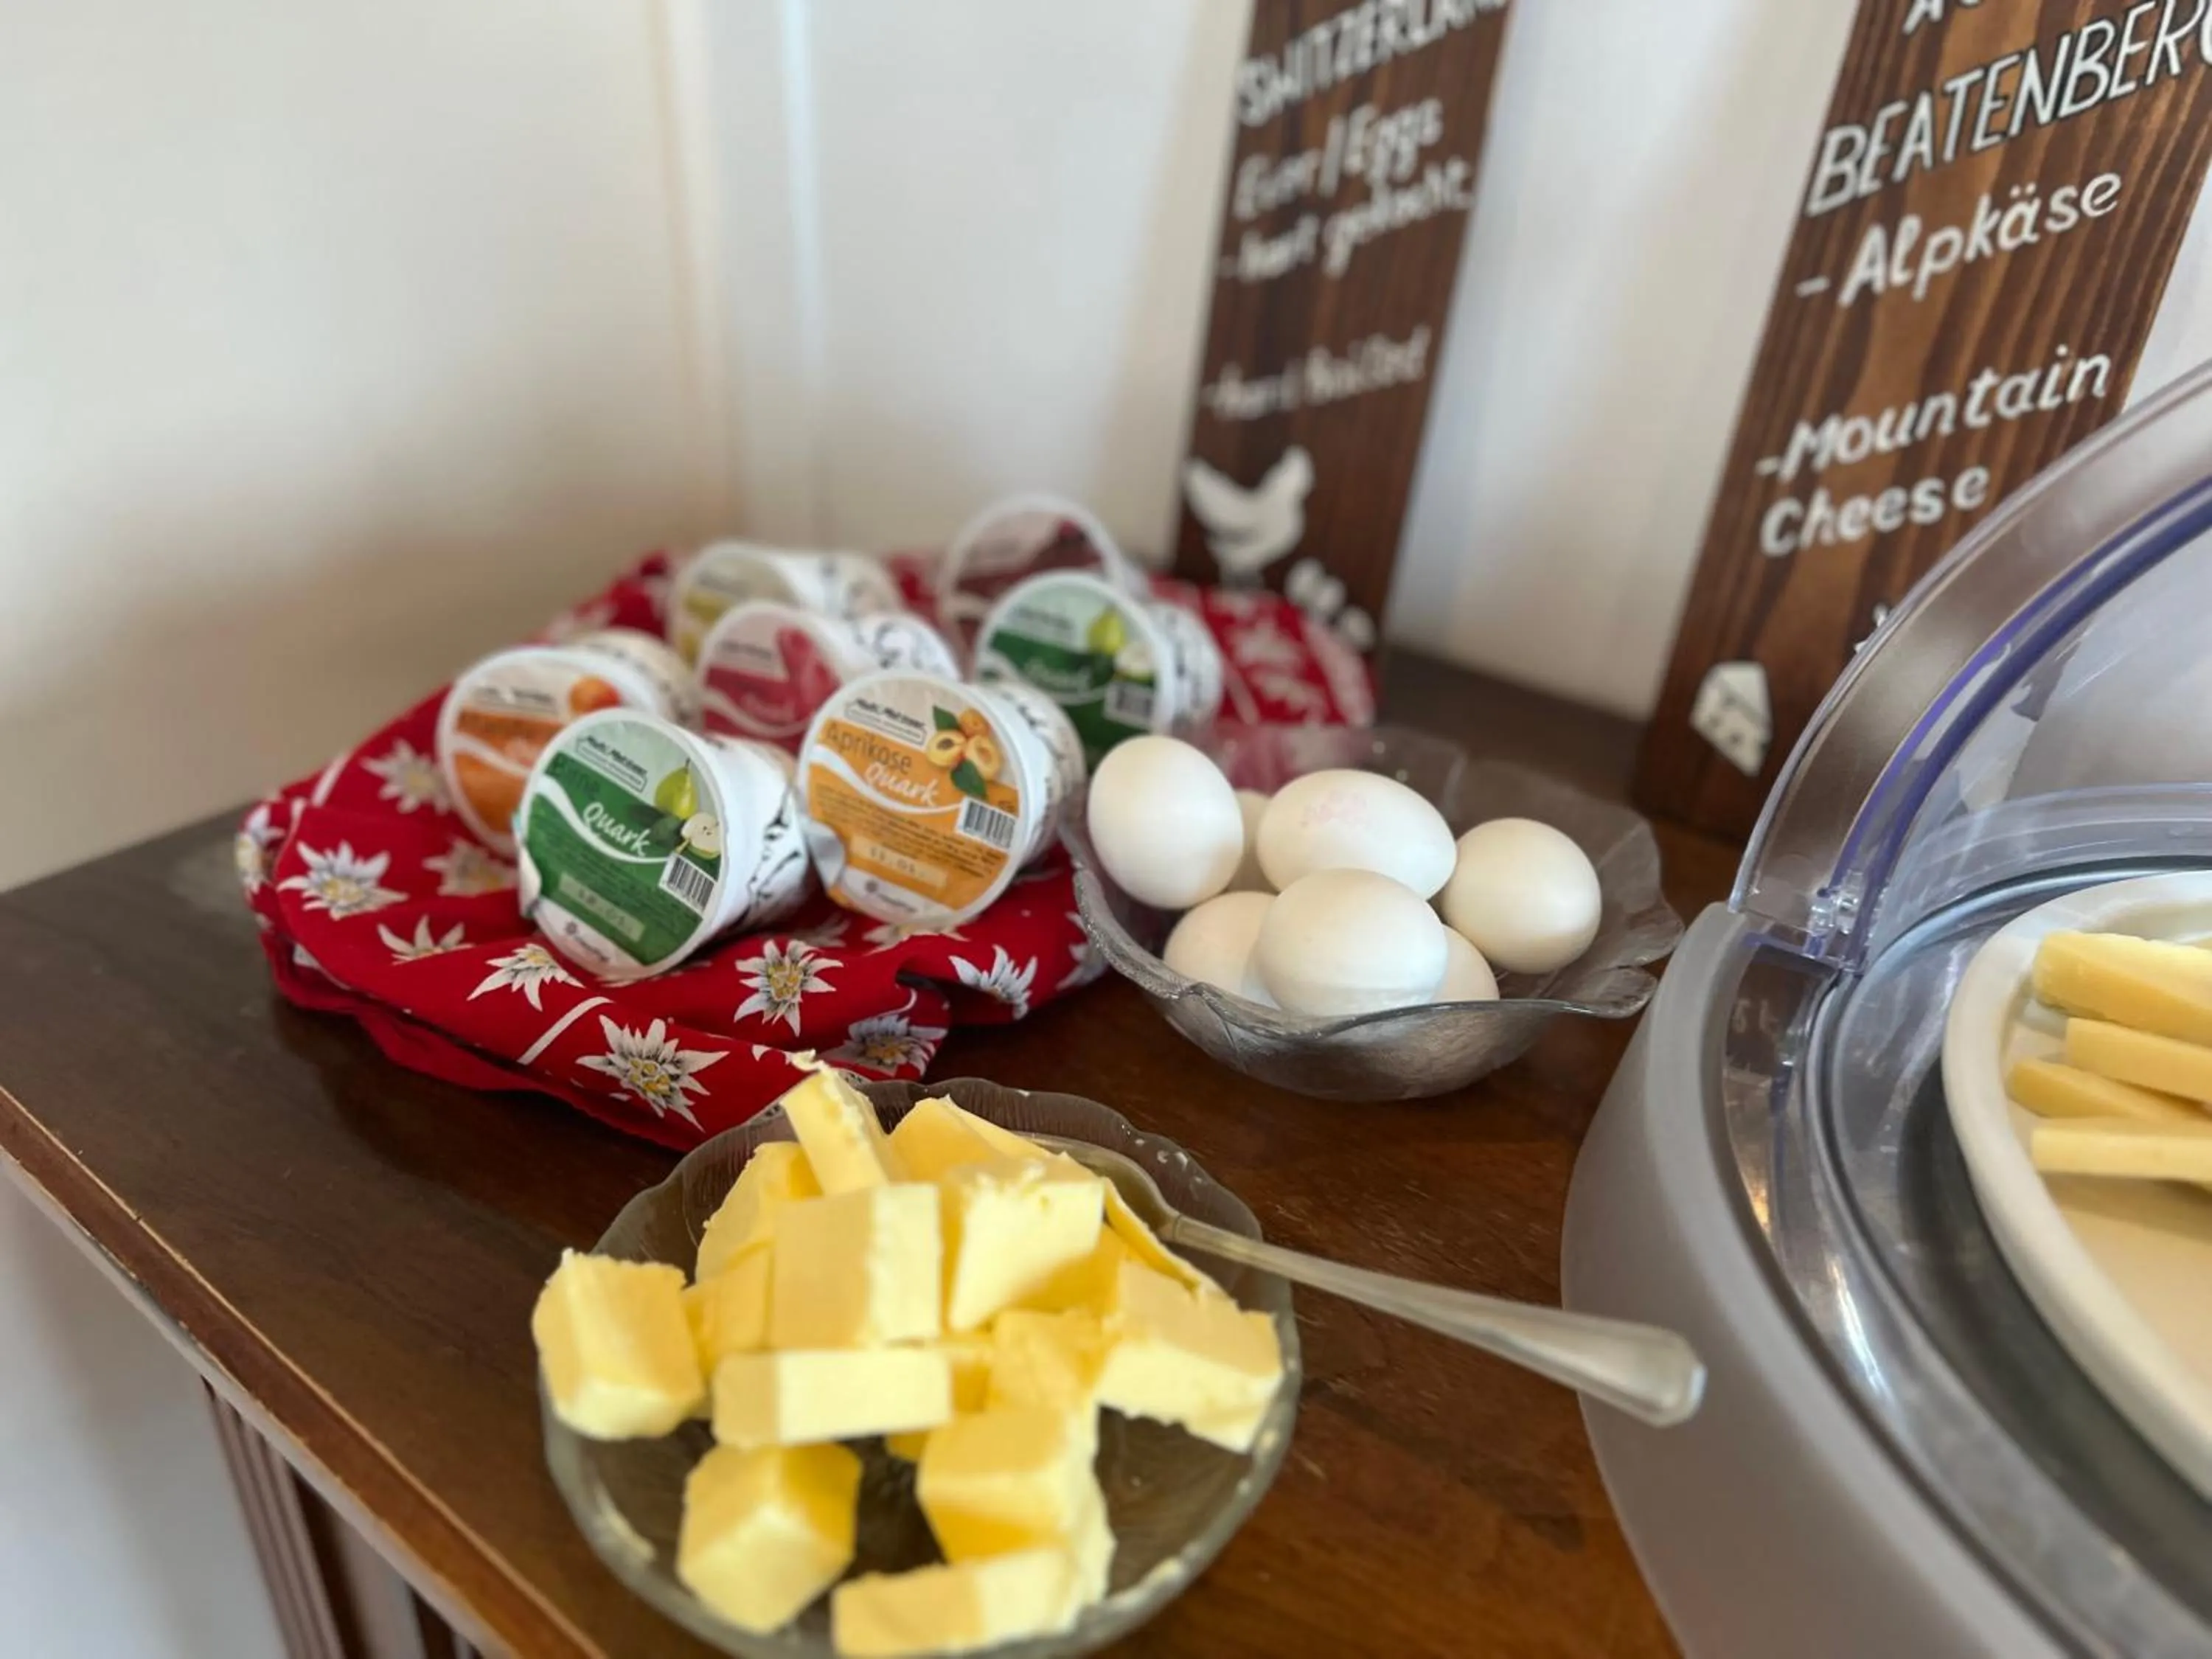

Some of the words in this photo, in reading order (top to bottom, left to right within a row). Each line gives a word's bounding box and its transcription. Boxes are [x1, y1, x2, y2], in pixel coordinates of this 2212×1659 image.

[1759, 464, 1989, 557] Cheese
[863, 760, 940, 807] Quark
[582, 801, 653, 858] Quark
